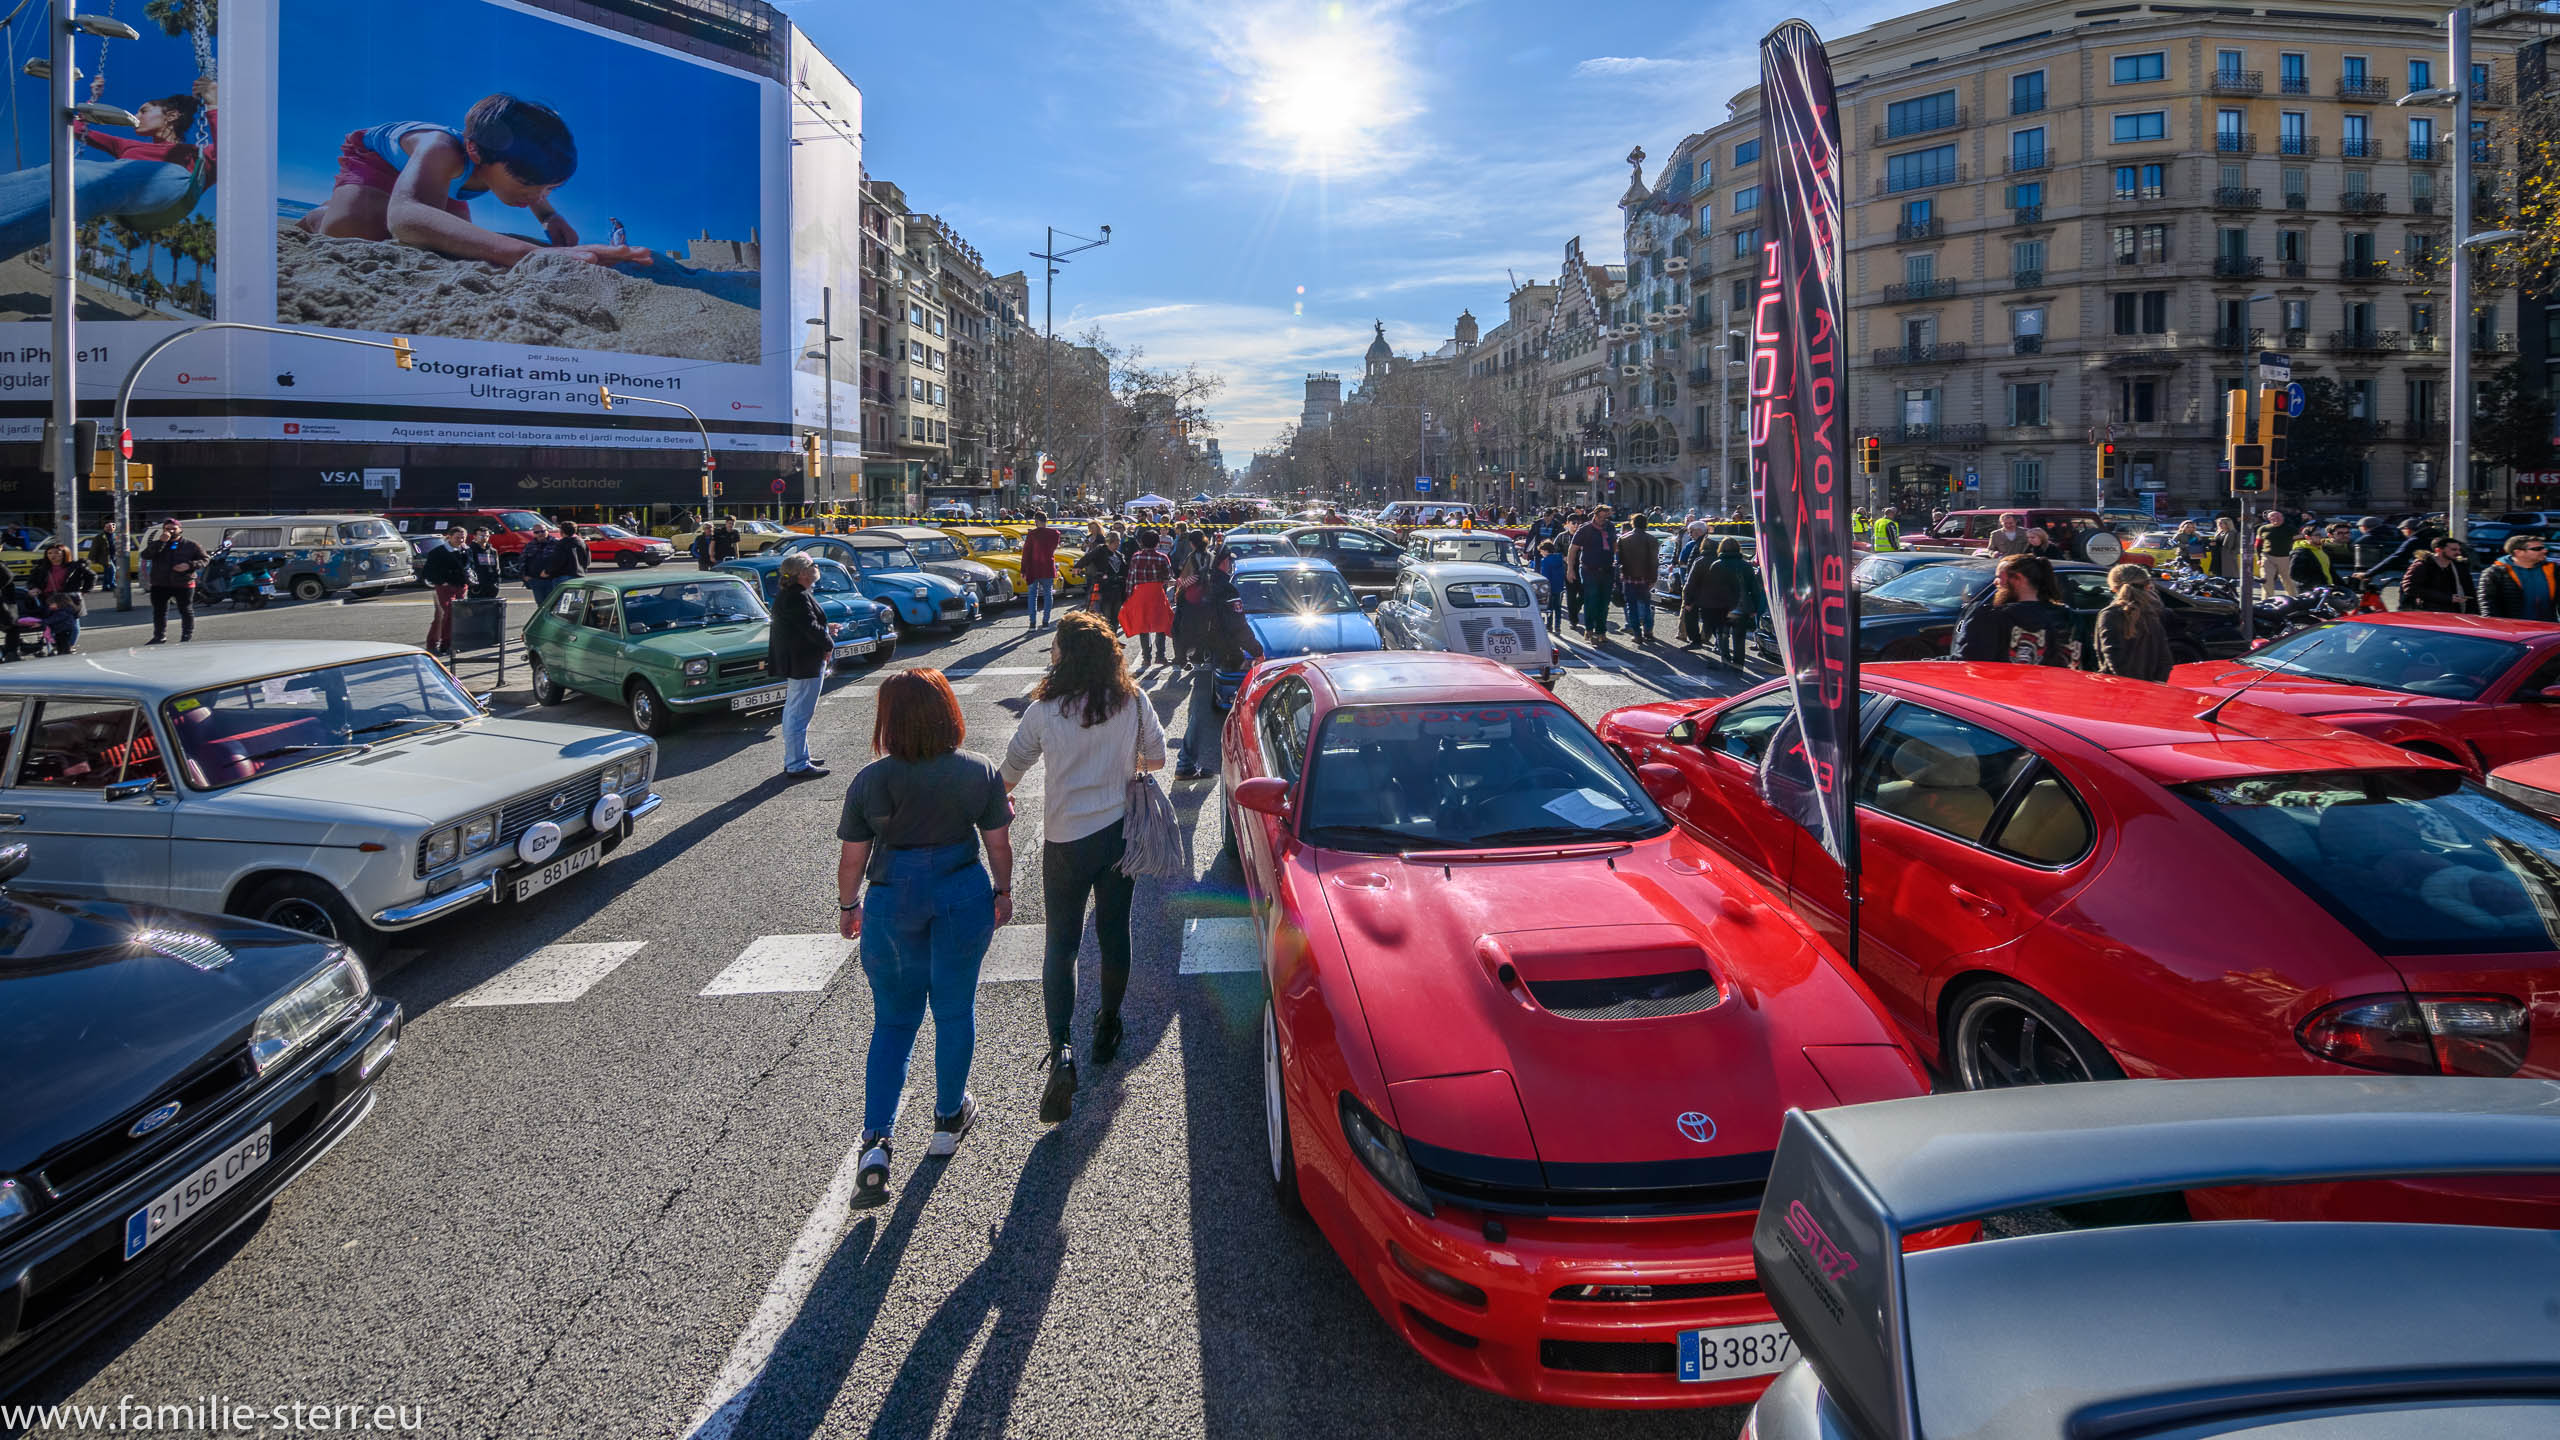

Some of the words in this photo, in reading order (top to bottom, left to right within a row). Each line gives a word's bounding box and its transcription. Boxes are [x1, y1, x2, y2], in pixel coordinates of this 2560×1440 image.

[20, 347, 88, 363] iPhe
[91, 346, 108, 362] 11
[545, 354, 570, 363] Jason
[529, 369, 571, 382] amb
[577, 373, 599, 384] un
[604, 372, 664, 389] iPhone
[667, 377, 681, 390] 11
[470, 383, 560, 402] Ultragran
[565, 391, 630, 406] anglar
[391, 427, 434, 439] Aquest
[438, 428, 496, 438] anunciant
[554, 431, 577, 441] amb
[579, 433, 589, 441] el
[615, 434, 654, 444] modular
[542, 476, 623, 489] Santander
[1494, 645, 1512, 654] 630
[1390, 706, 1557, 724] TOYOTA
[151, 1169, 217, 1235] 2156
[225, 1133, 270, 1180] CPB
[132, 1234, 143, 1248] E
[1685, 1361, 1695, 1372] E
